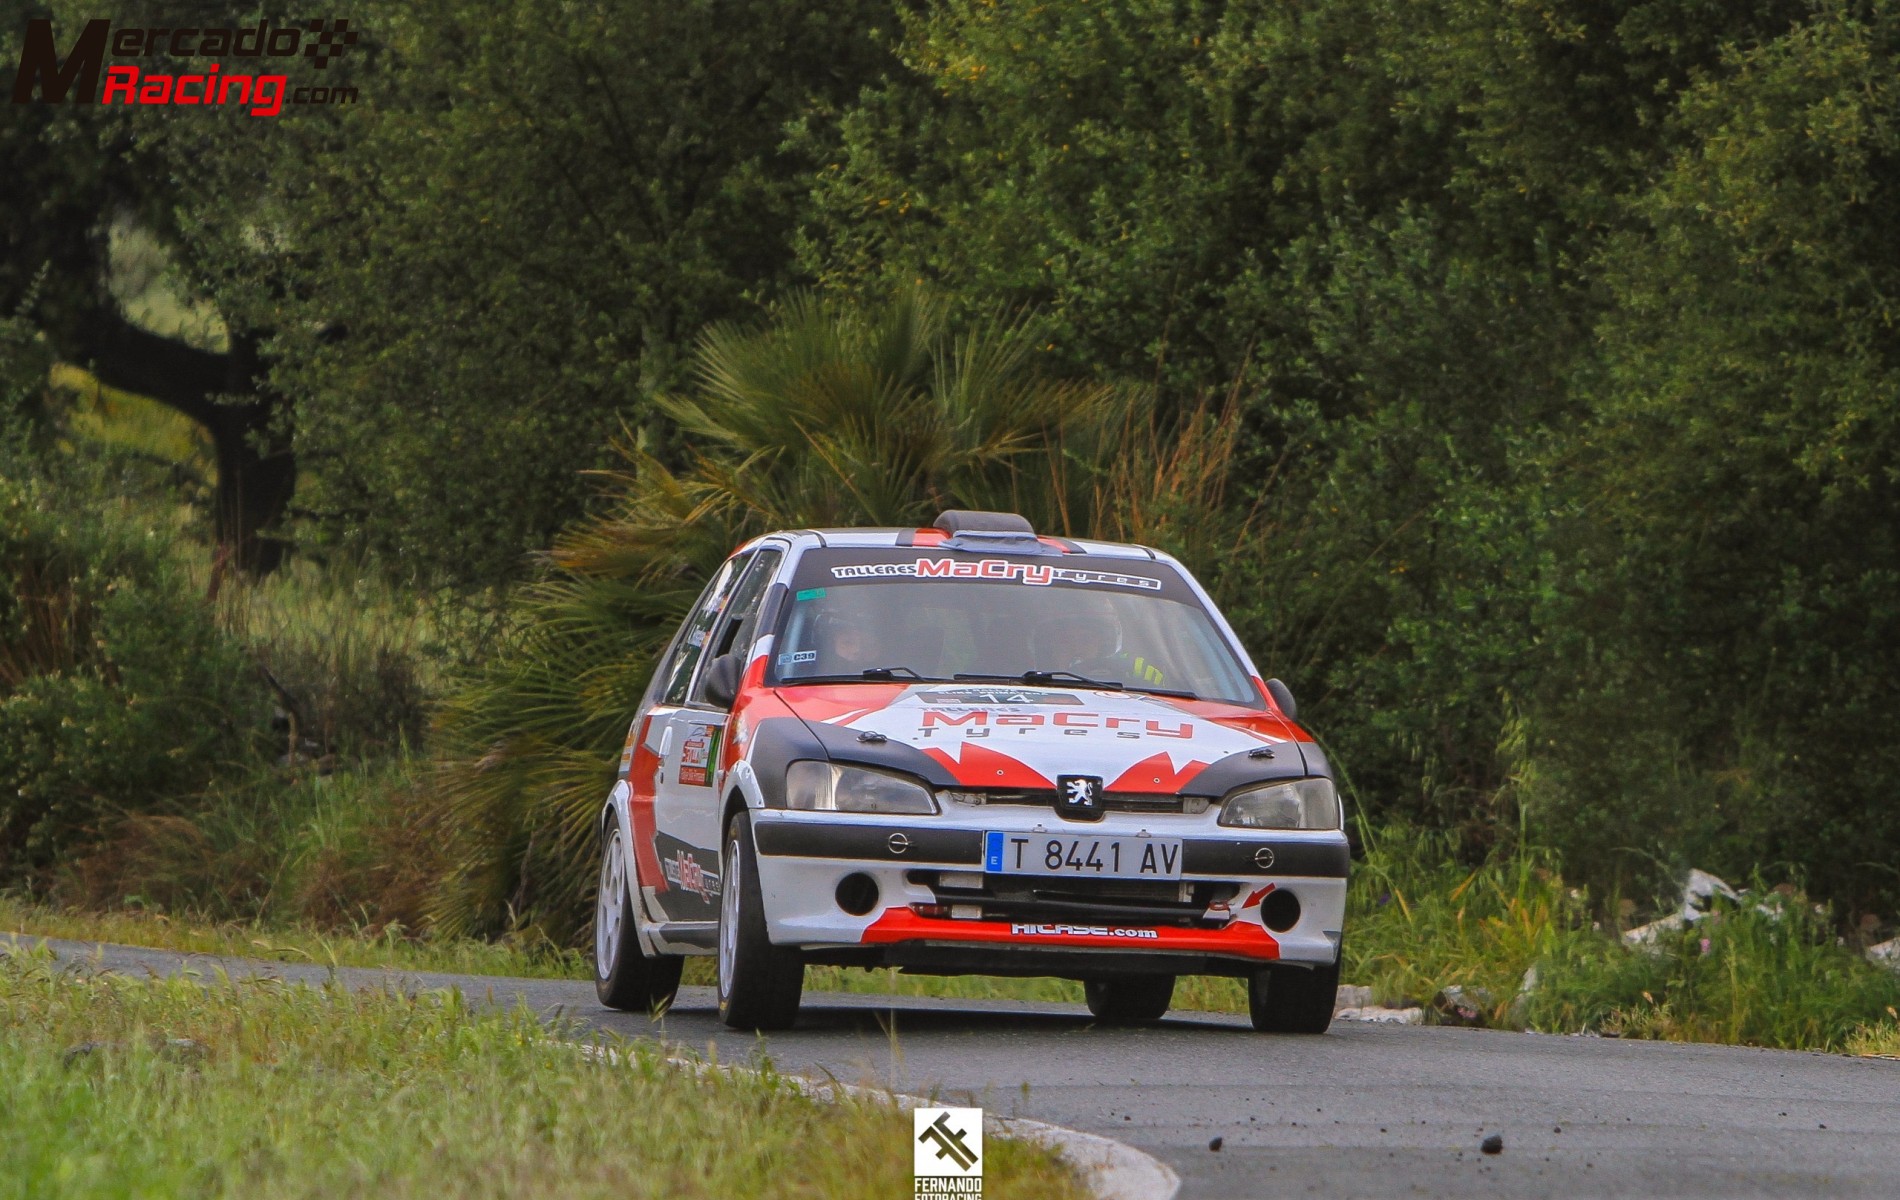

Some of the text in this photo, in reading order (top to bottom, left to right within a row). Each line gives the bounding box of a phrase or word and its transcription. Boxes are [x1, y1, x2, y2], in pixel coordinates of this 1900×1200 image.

[833, 564, 917, 577] TALLERES
[916, 560, 1051, 583] MaCry
[794, 652, 815, 661] C39
[979, 694, 1034, 704] 14
[922, 711, 1193, 739] MaCry
[918, 727, 1141, 740] Tyres
[990, 856, 998, 865] E
[1011, 838, 1179, 874] T 8441 AV
